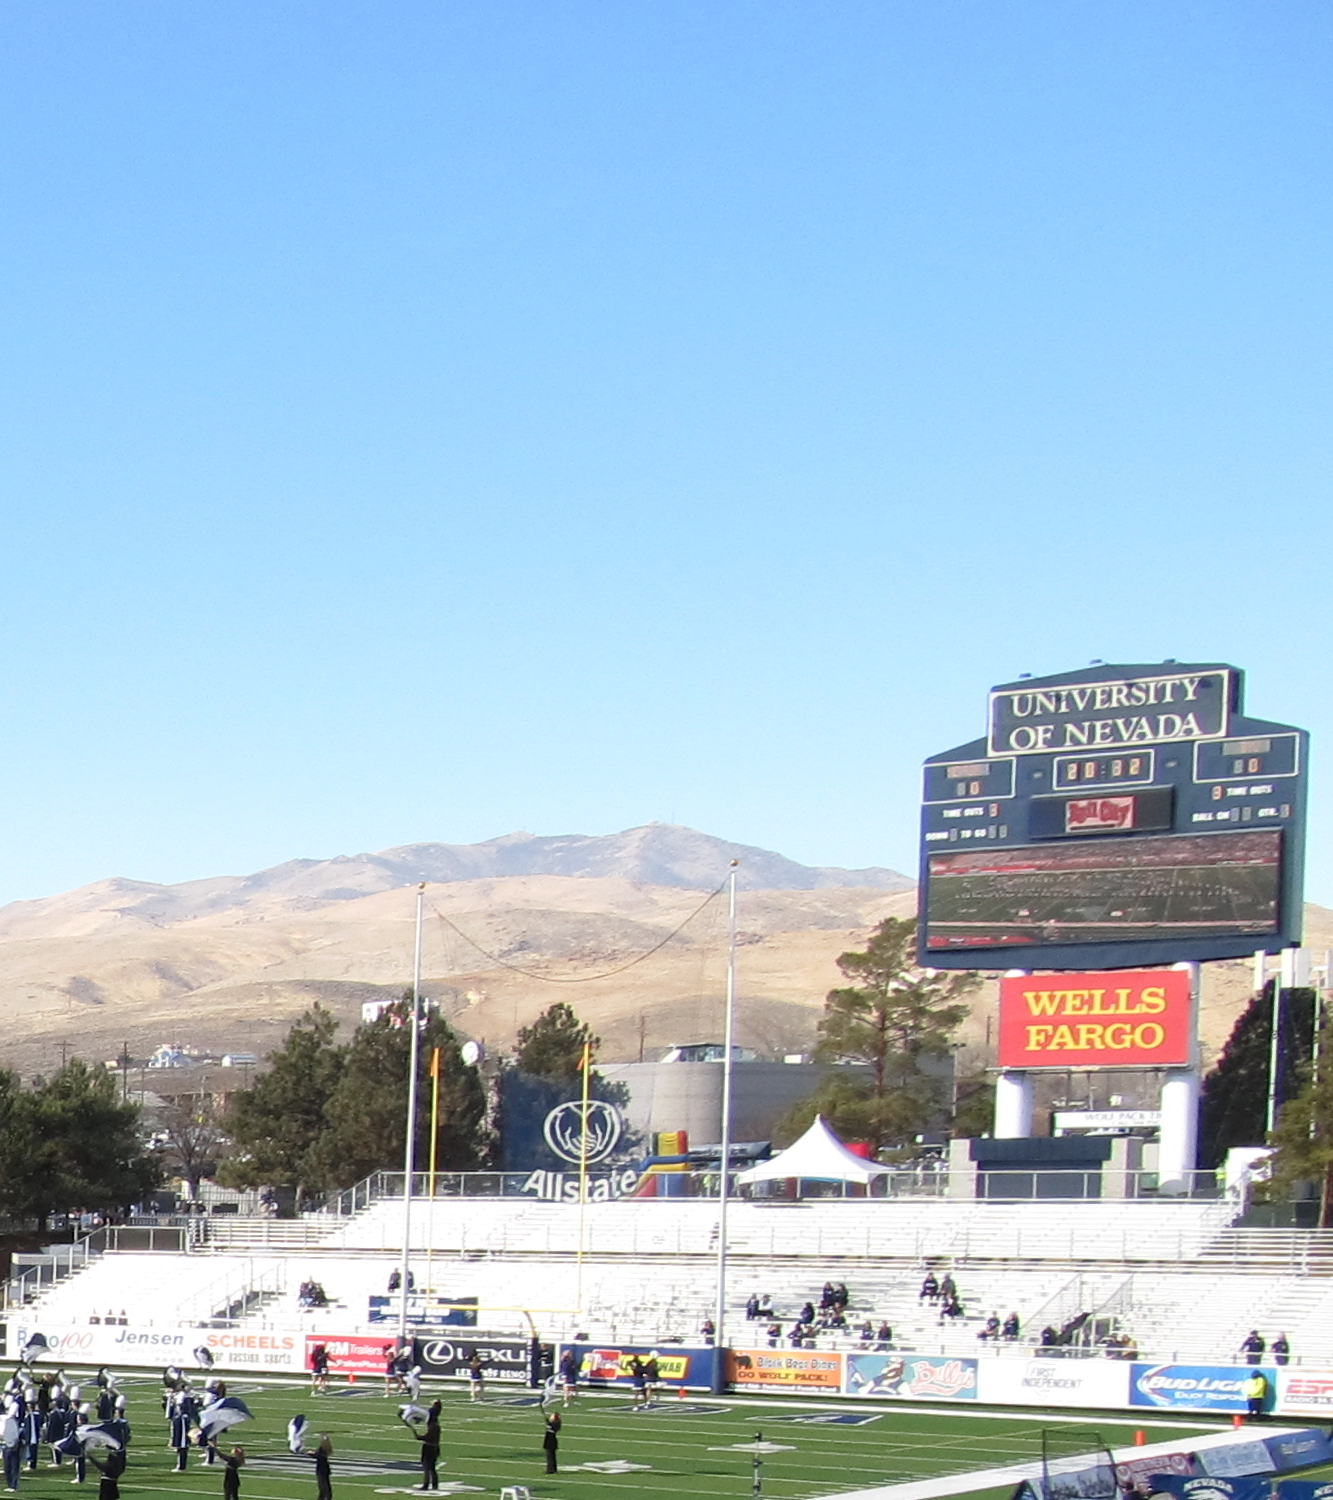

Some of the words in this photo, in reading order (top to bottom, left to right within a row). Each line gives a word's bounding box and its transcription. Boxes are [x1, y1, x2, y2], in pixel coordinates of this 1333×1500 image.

[1010, 676, 1201, 718] UNIVERSITY
[1009, 725, 1055, 751] OF
[1065, 711, 1203, 747] NEVADA
[1023, 987, 1166, 1018] WELLS
[1024, 1022, 1165, 1052] FARGO
[521, 1168, 640, 1204] Allstate
[115, 1329, 184, 1346] Jensen
[206, 1334, 295, 1350] SCHEELS
[306, 1340, 350, 1357] TAM
[456, 1348, 528, 1363] LEXU
[738, 1371, 755, 1379] GO
[758, 1372, 791, 1380] WOLF
[1197, 1377, 1246, 1392] LIGH
[1286, 1378, 1333, 1394] ESP
[1183, 1478, 1234, 1493] NEVADA
